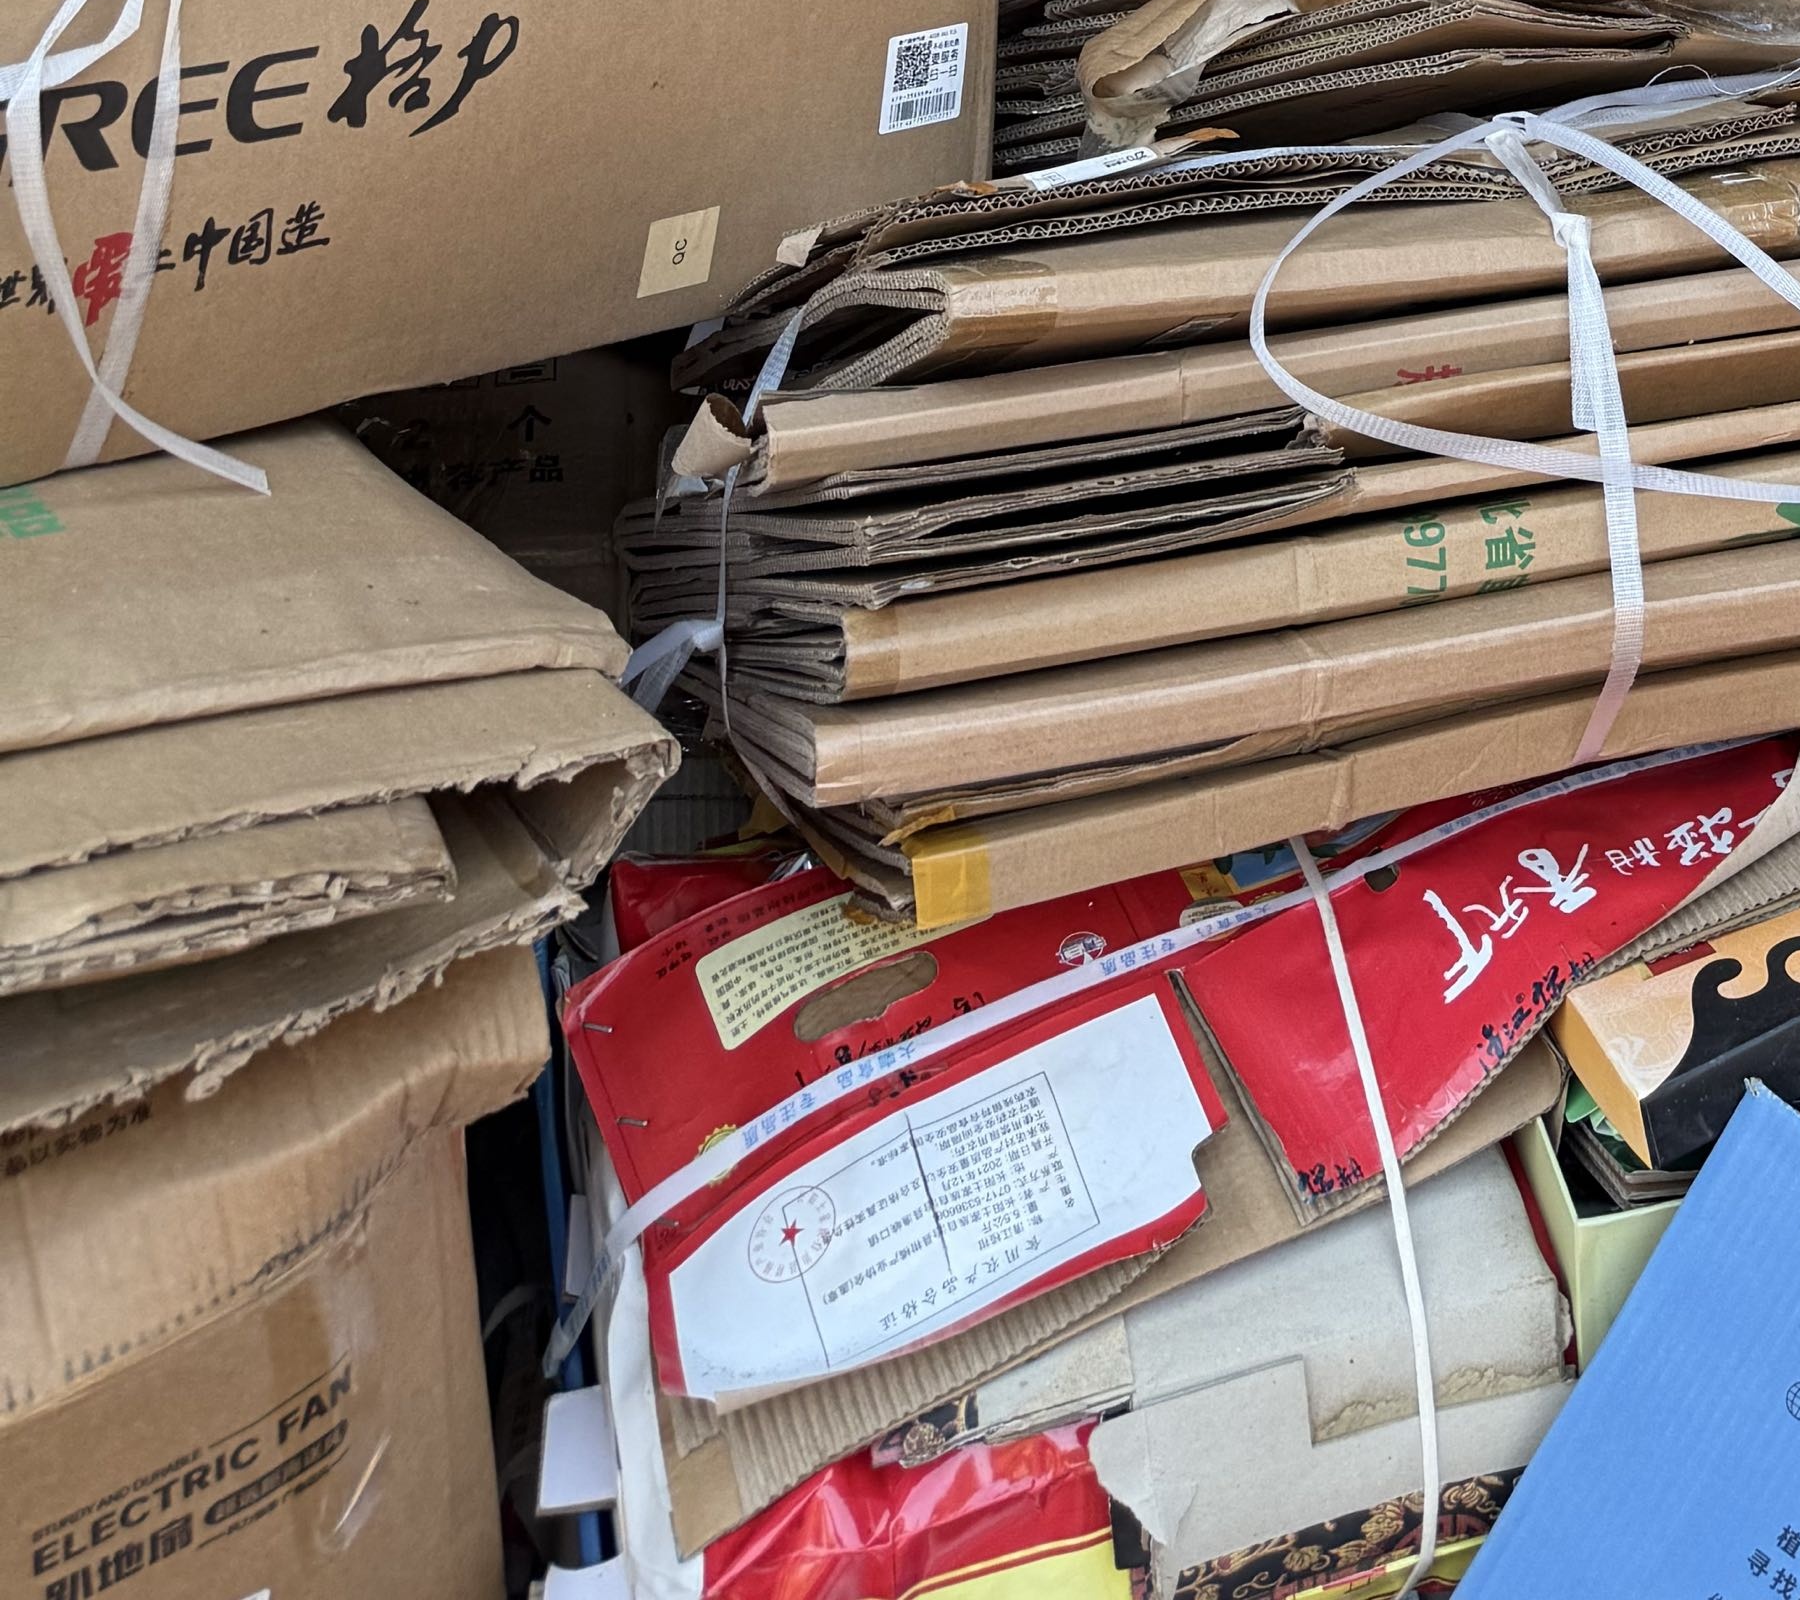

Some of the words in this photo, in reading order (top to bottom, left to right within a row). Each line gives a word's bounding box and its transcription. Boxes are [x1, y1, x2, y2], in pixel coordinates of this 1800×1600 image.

[1416, 833, 1603, 1001] 香天下
[939, 1156, 1002, 1191] 2021年12月
[979, 1207, 1020, 1234] 5.5公斤
[875, 1233, 1041, 1332] 食用农产品合格证
[32, 1437, 261, 1577] ELECTRIC
[277, 1360, 353, 1446] FAN
